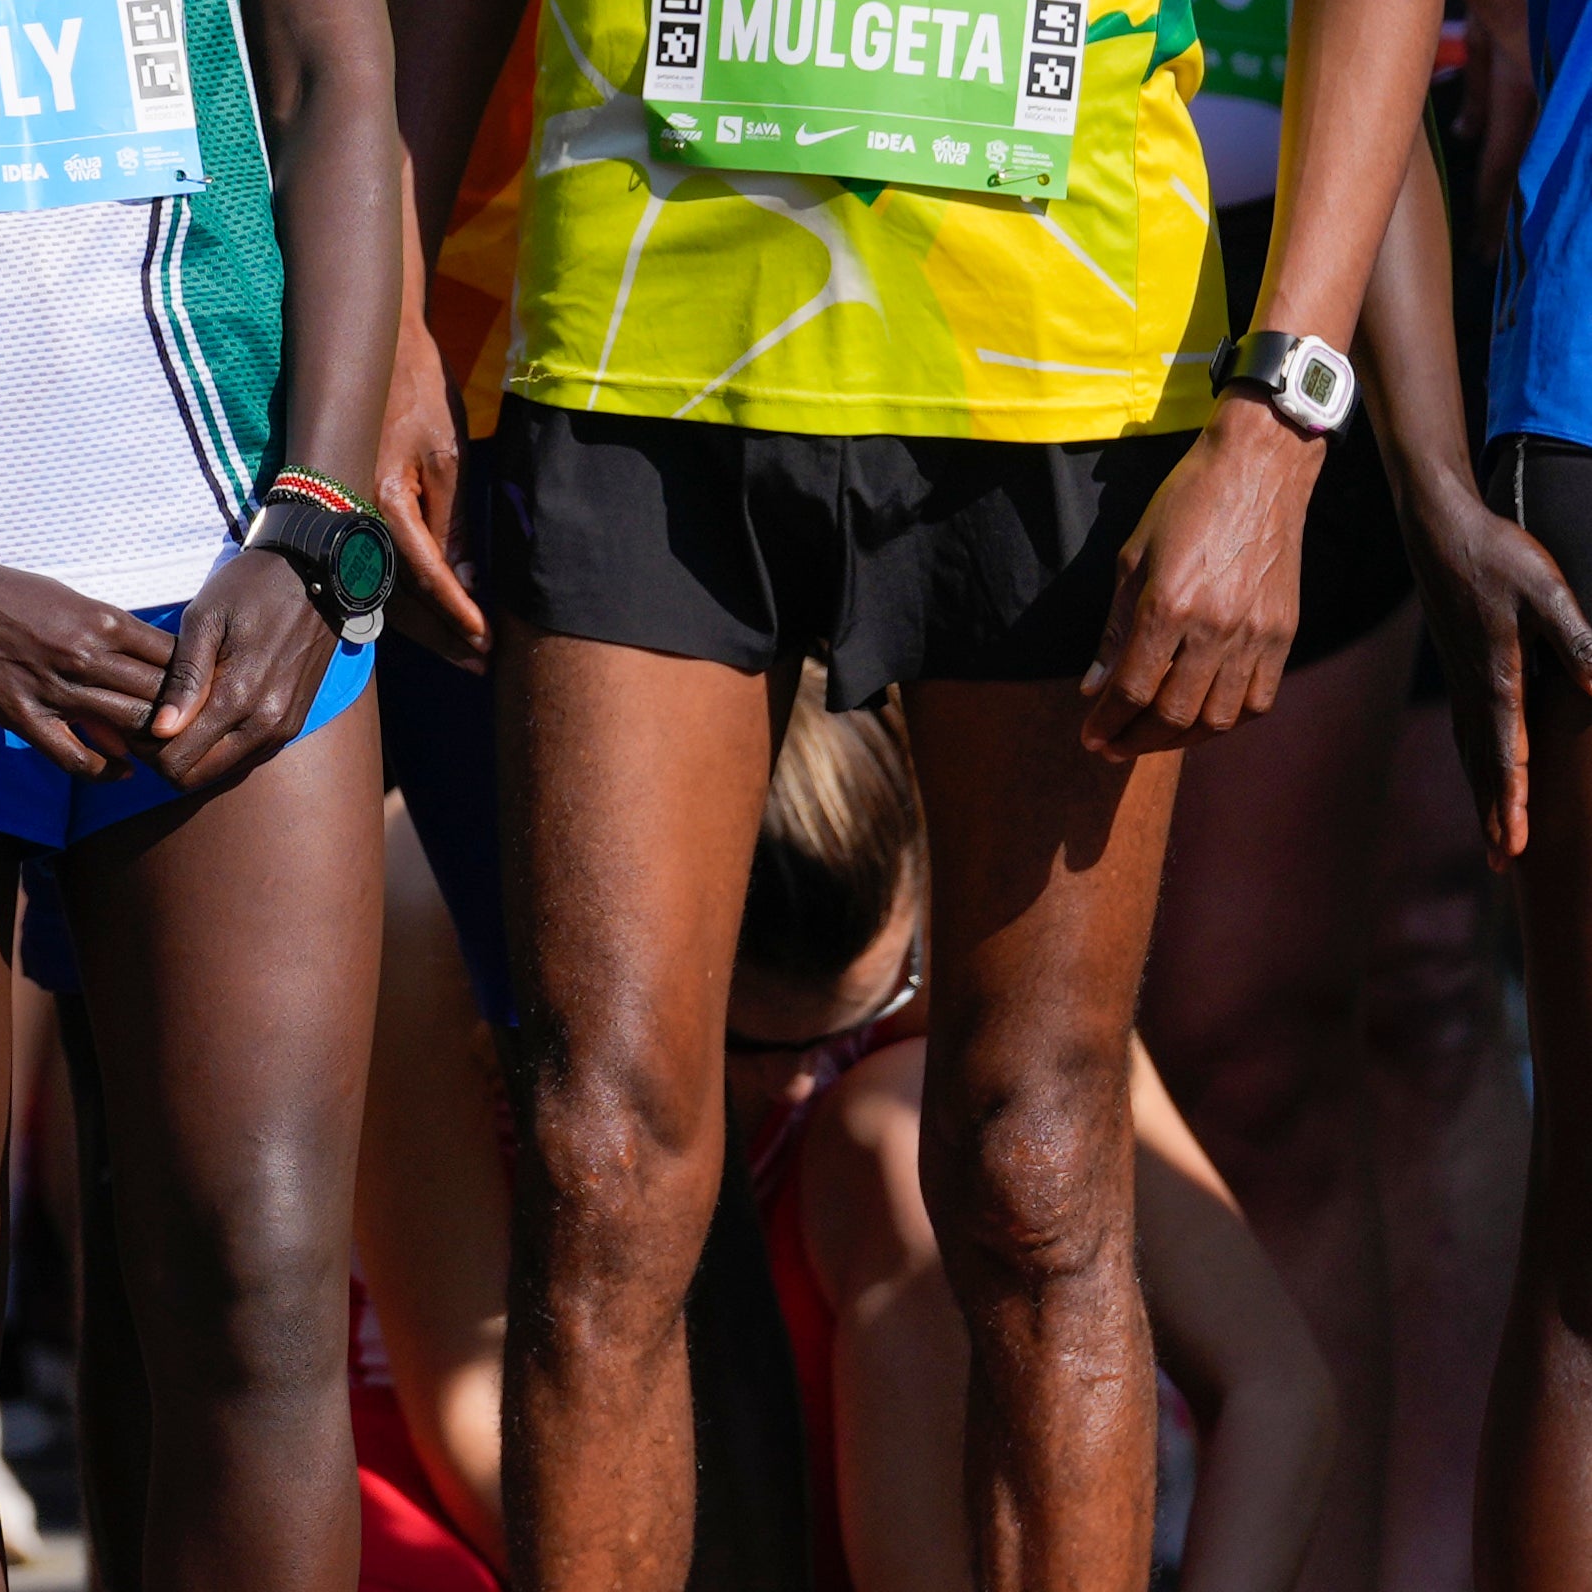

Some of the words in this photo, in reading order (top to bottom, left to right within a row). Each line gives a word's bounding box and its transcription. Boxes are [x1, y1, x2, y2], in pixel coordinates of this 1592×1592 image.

[746, 121, 781, 136] SAVA
[867, 131, 916, 153] IDEA
[1, 163, 50, 182] IDEA
